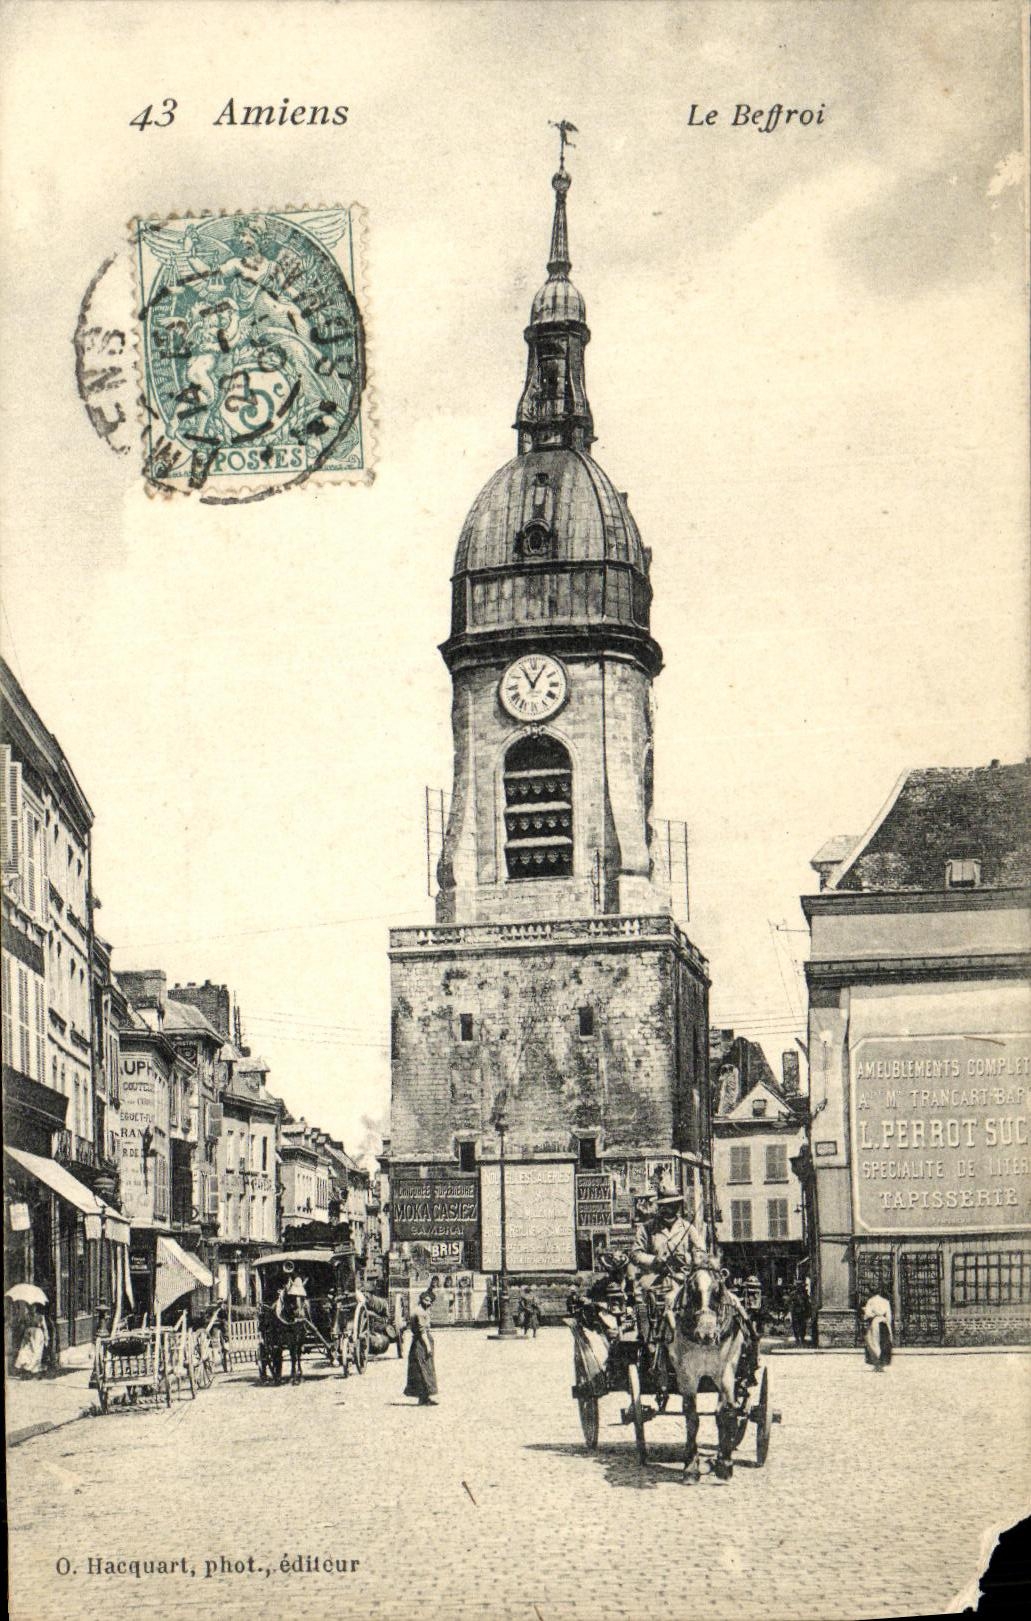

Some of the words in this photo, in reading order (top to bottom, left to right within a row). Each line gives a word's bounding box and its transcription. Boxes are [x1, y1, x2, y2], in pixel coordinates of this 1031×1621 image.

[857, 1059, 960, 1080] AMEUBLEMENTS
[862, 1160, 945, 1180] SPECIALITE
[957, 1159, 976, 1178] DE
[880, 1187, 1019, 1211] TAPISSERIE
[394, 1202, 431, 1222] MOKA
